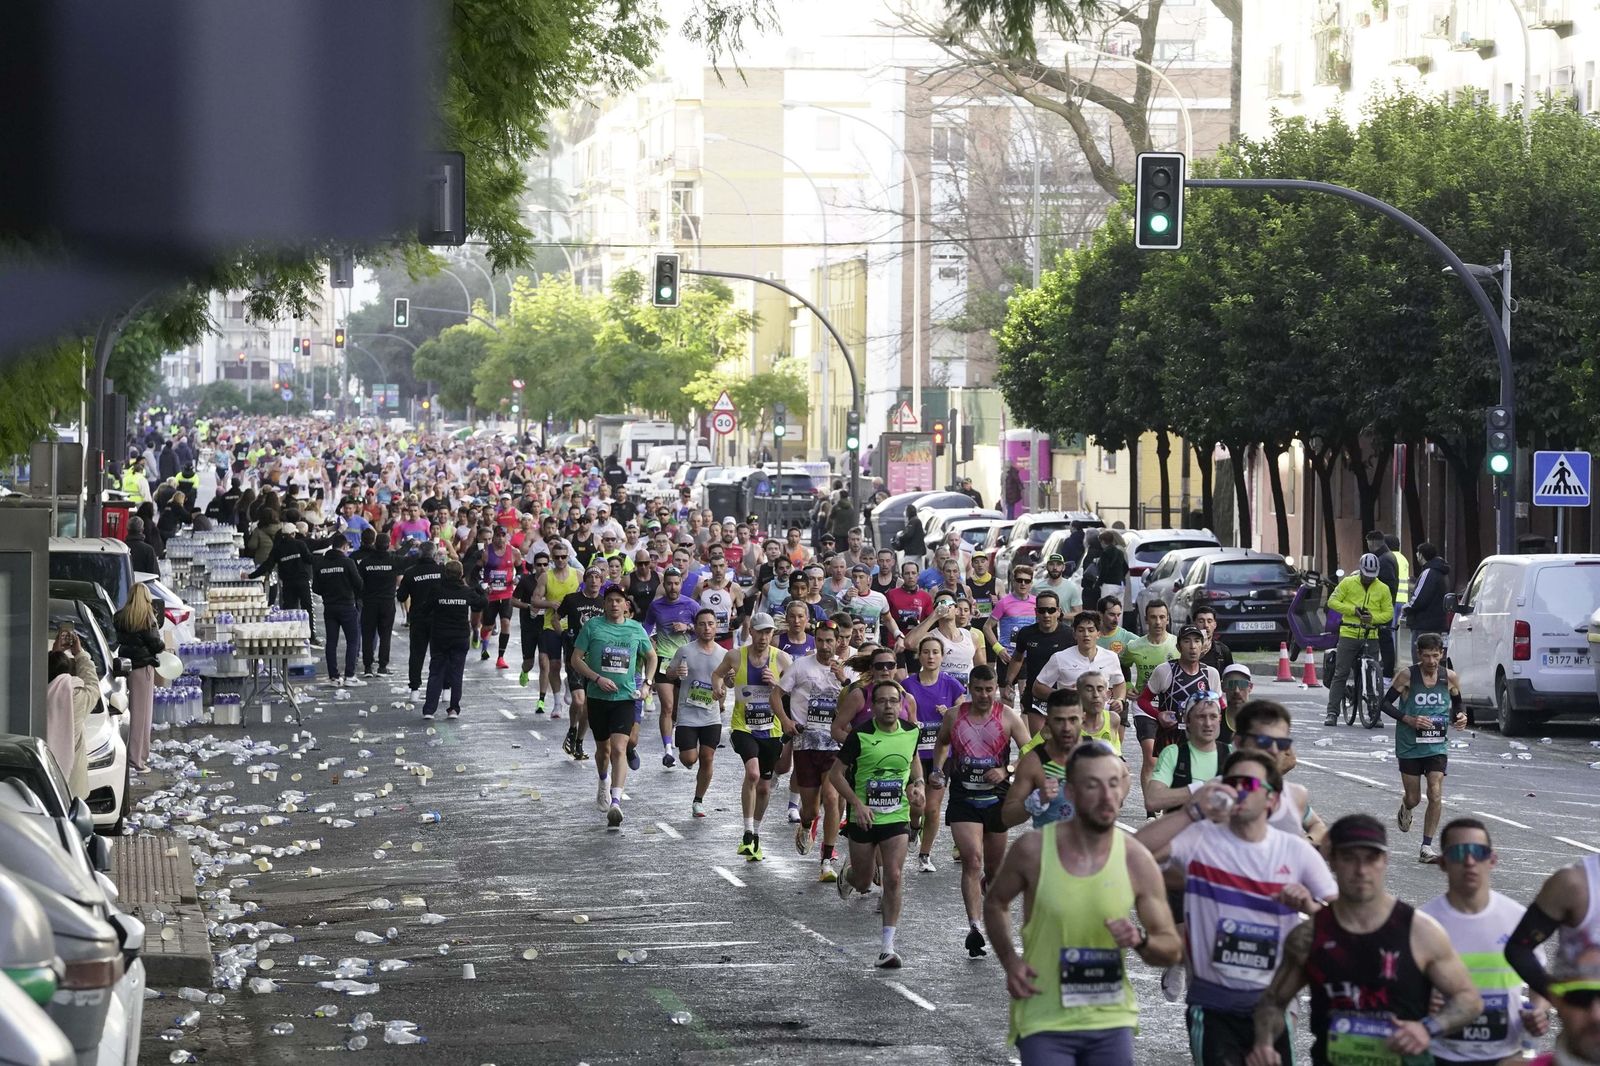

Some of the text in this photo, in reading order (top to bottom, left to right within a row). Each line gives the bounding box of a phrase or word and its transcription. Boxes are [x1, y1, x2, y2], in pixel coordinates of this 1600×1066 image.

[717, 419, 731, 427] 30
[320, 566, 345, 574] VOLUNTEER
[413, 573, 442, 582] VOLUNTEER
[1549, 656, 1591, 665] 9177 MFY
[869, 798, 900, 806] MARIANO
[1239, 924, 1275, 936] ZURICH
[1083, 950, 1119, 960] ZURICH
[1221, 949, 1269, 969] DAMIEN
[1463, 1026, 1490, 1040] KAD
